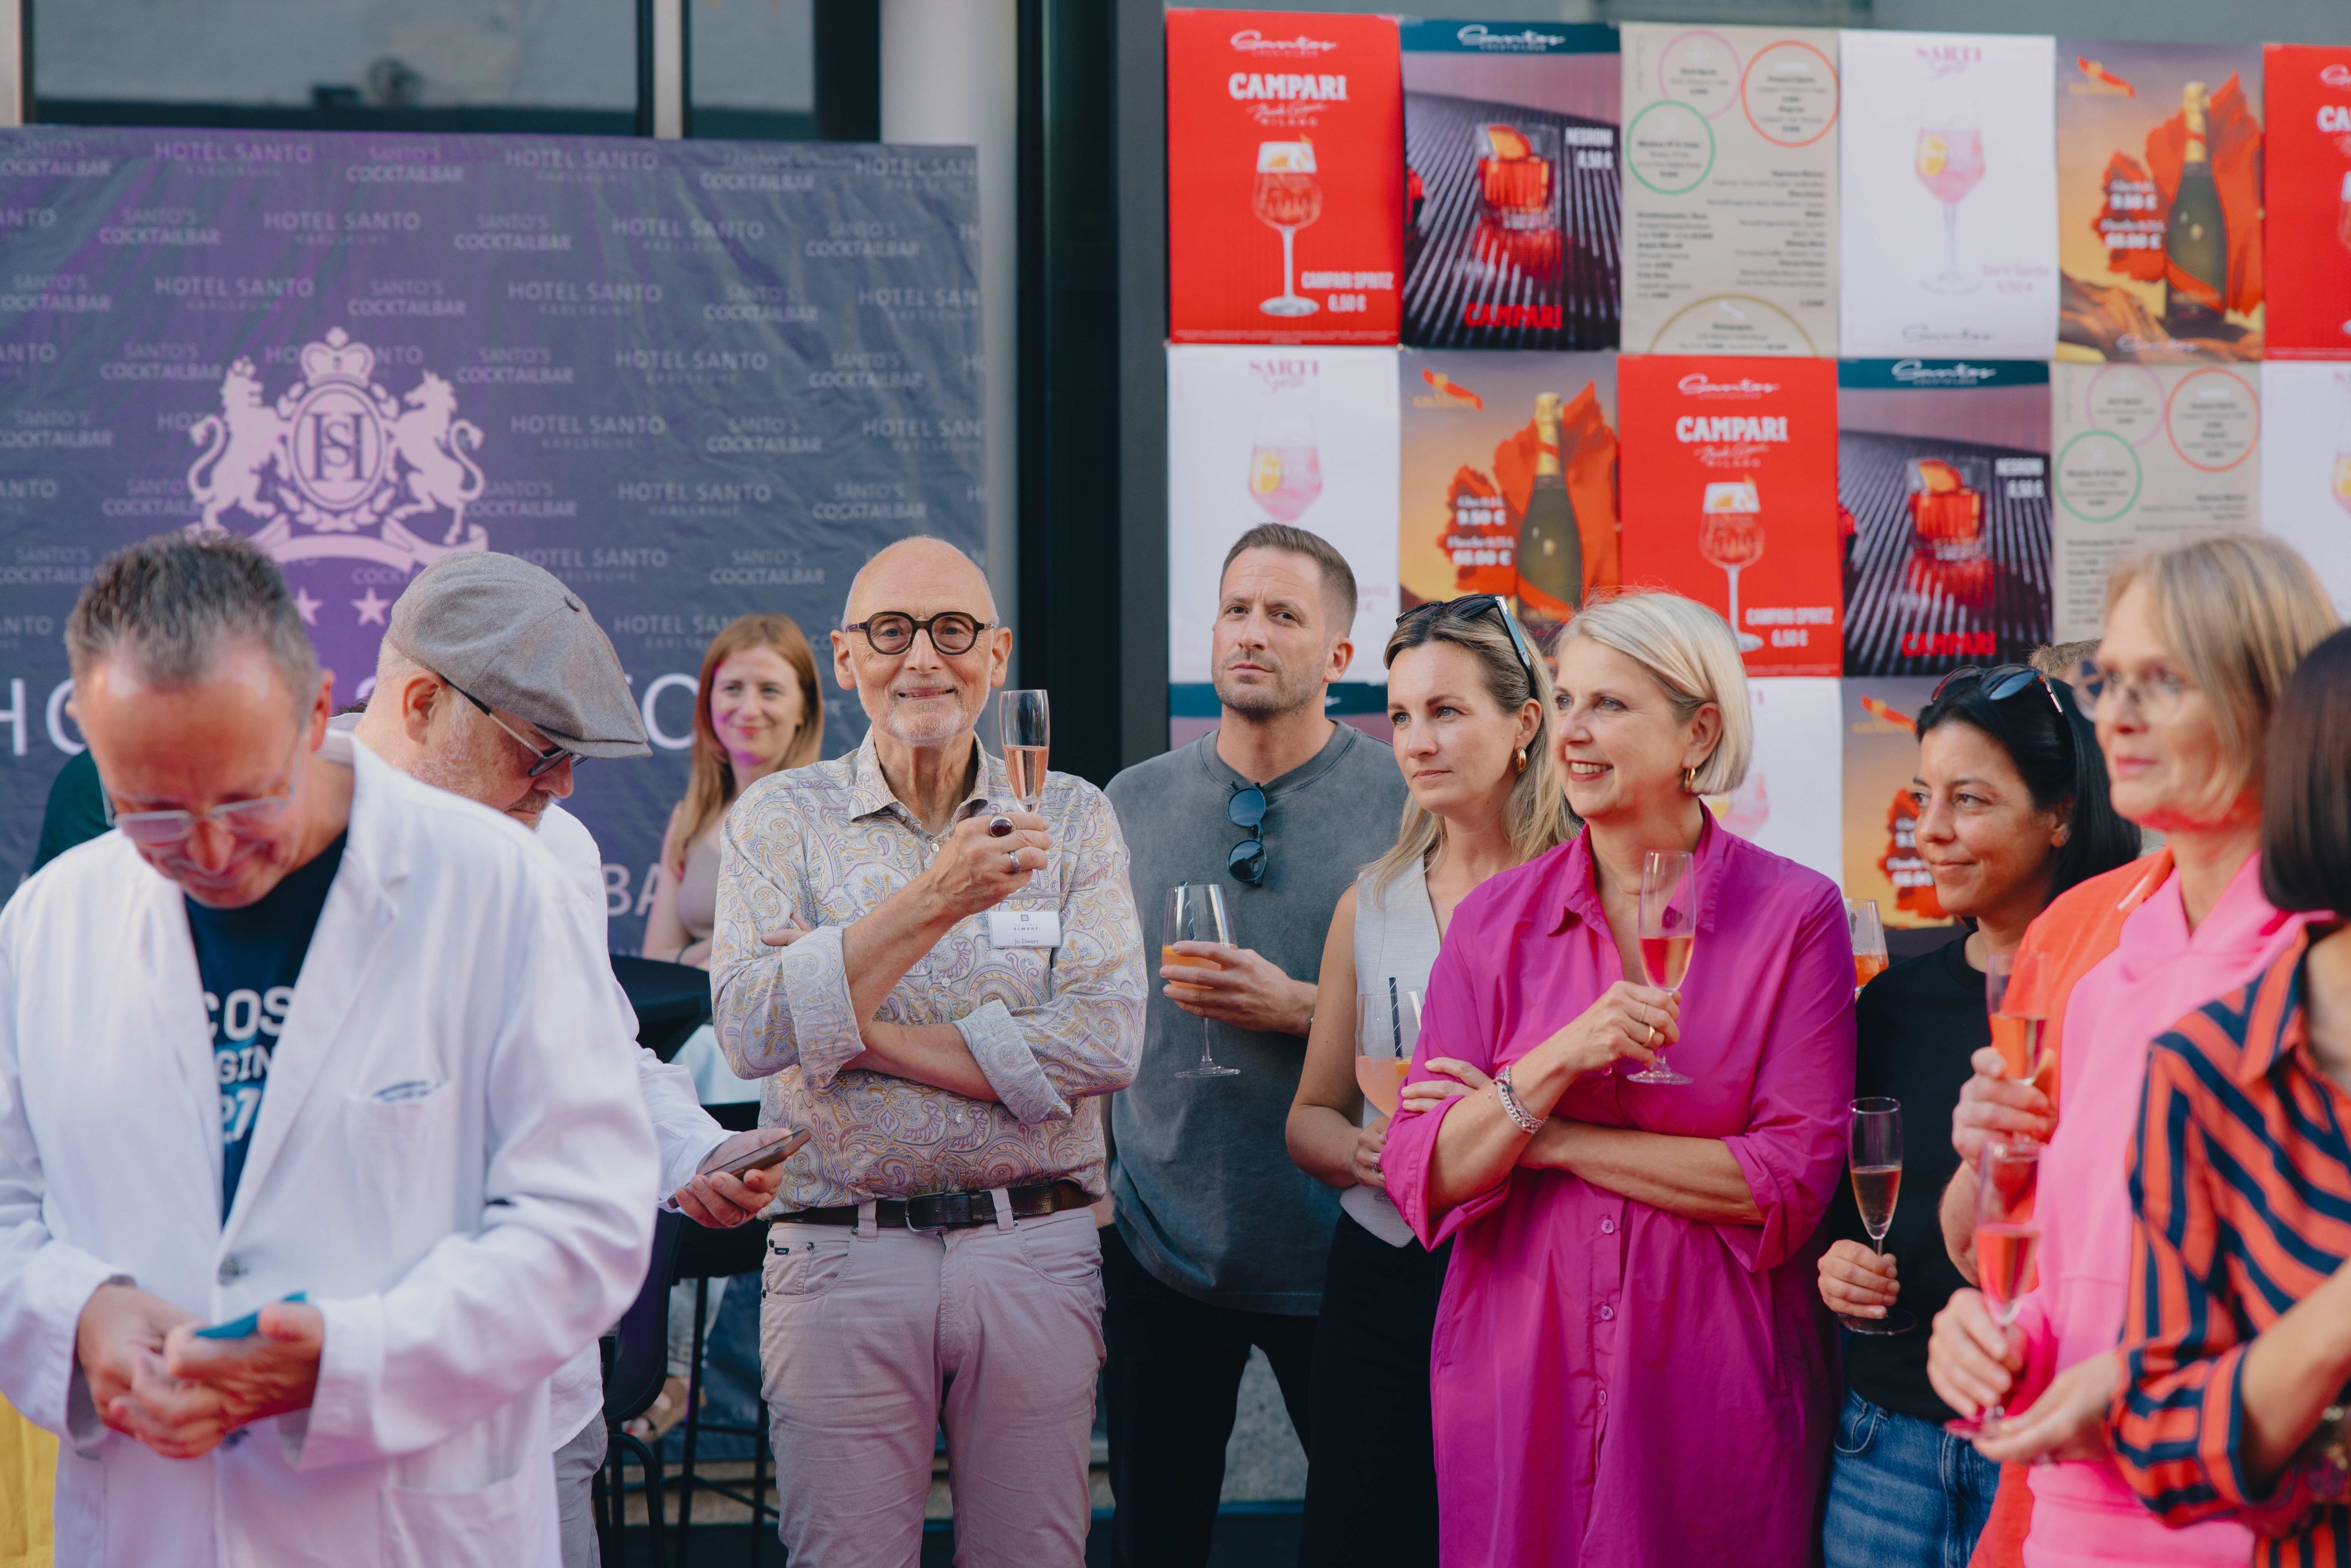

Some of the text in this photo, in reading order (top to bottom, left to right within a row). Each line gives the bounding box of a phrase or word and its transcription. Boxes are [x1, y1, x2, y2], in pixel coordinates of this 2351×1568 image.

[1228, 72, 1347, 101] CAMPARI
[1565, 126, 1614, 148] NEGRONI
[155, 142, 314, 165] HOTEL SANTO
[505, 148, 659, 172] HOTEL SANTO
[0, 159, 112, 176] OCKTAILBAR
[346, 166, 465, 183] COCKTAILBAR
[0, 207, 58, 229] ANTO
[263, 210, 421, 232] HOTEL SANTO
[611, 216, 765, 240] HOTEL SANTO
[98, 227, 222, 246] COCKTAILBAR
[452, 233, 572, 252] COCKTAILBAR
[804, 239, 920, 257] COCKTAILBAR
[154, 276, 316, 299] HOTEL SANTO
[507, 280, 664, 304] HOTEL SANTO
[0, 294, 113, 313] OCKTAILBAR
[347, 298, 467, 317] COCKTAILBAR
[858, 287, 979, 309] HOTEL SAN
[703, 303, 818, 323] COCKTAILBAR
[1464, 301, 1563, 330] CAMPARI
[0, 342, 58, 364] ANTO
[615, 349, 769, 372] HOTEL SANTO
[99, 362, 223, 381] COCKTAILBAR
[456, 366, 575, 384] COCKTAILBAR
[1249, 359, 1319, 377] SARTI
[808, 370, 923, 389] COCKTAILBAR
[510, 414, 667, 437] HOTEL SANTO
[862, 418, 983, 438] HOTEL SAN
[1676, 416, 1789, 443] CAMPARI
[706, 435, 823, 454] COCKTAILBAR
[1996, 458, 2044, 477] NEGRONI
[0, 478, 59, 500] ANTO
[617, 482, 772, 504] HOTEL SANTO
[101, 498, 203, 517] COCKTAILB
[812, 502, 927, 520] COCKTAILBAR
[592, 548, 669, 568] SANTO
[709, 568, 826, 585] COCKTAILBAR
[613, 614, 684, 635] HOTEL
[1902, 631, 1997, 658] CAMPARI
